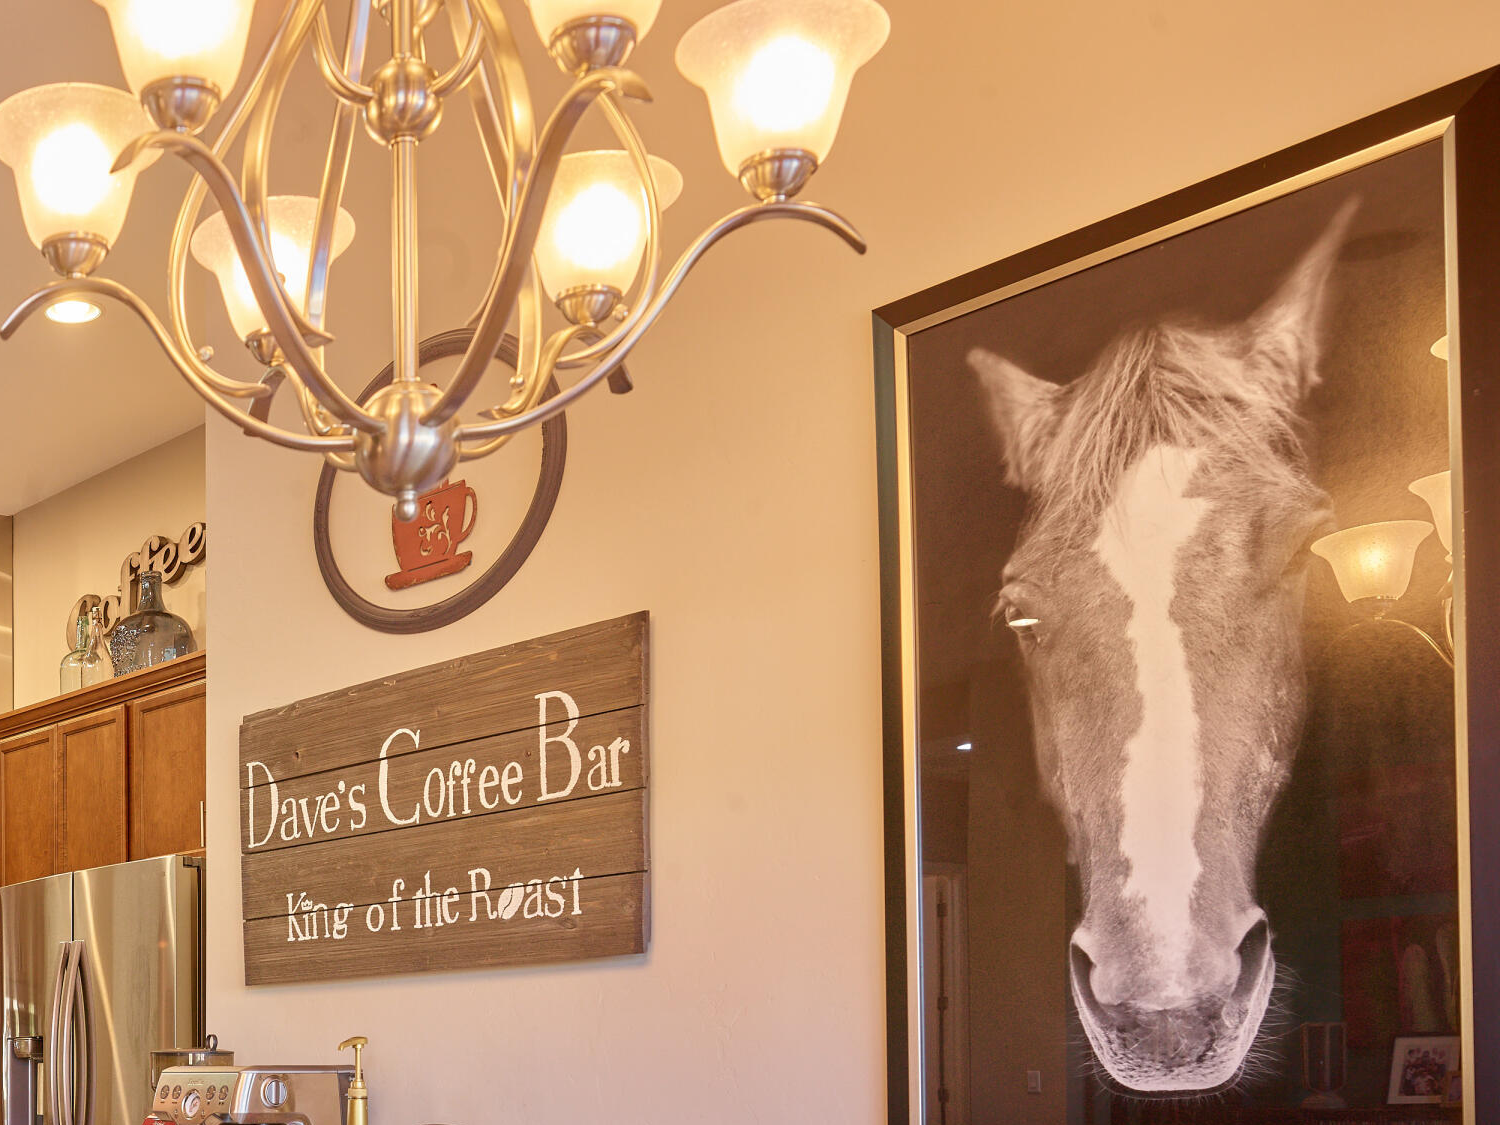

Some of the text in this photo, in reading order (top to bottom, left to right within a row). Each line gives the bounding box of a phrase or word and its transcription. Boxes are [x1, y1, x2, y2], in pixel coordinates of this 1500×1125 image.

[245, 690, 631, 849] Dave's Coffee Bar
[286, 867, 585, 942] King of the Roast
